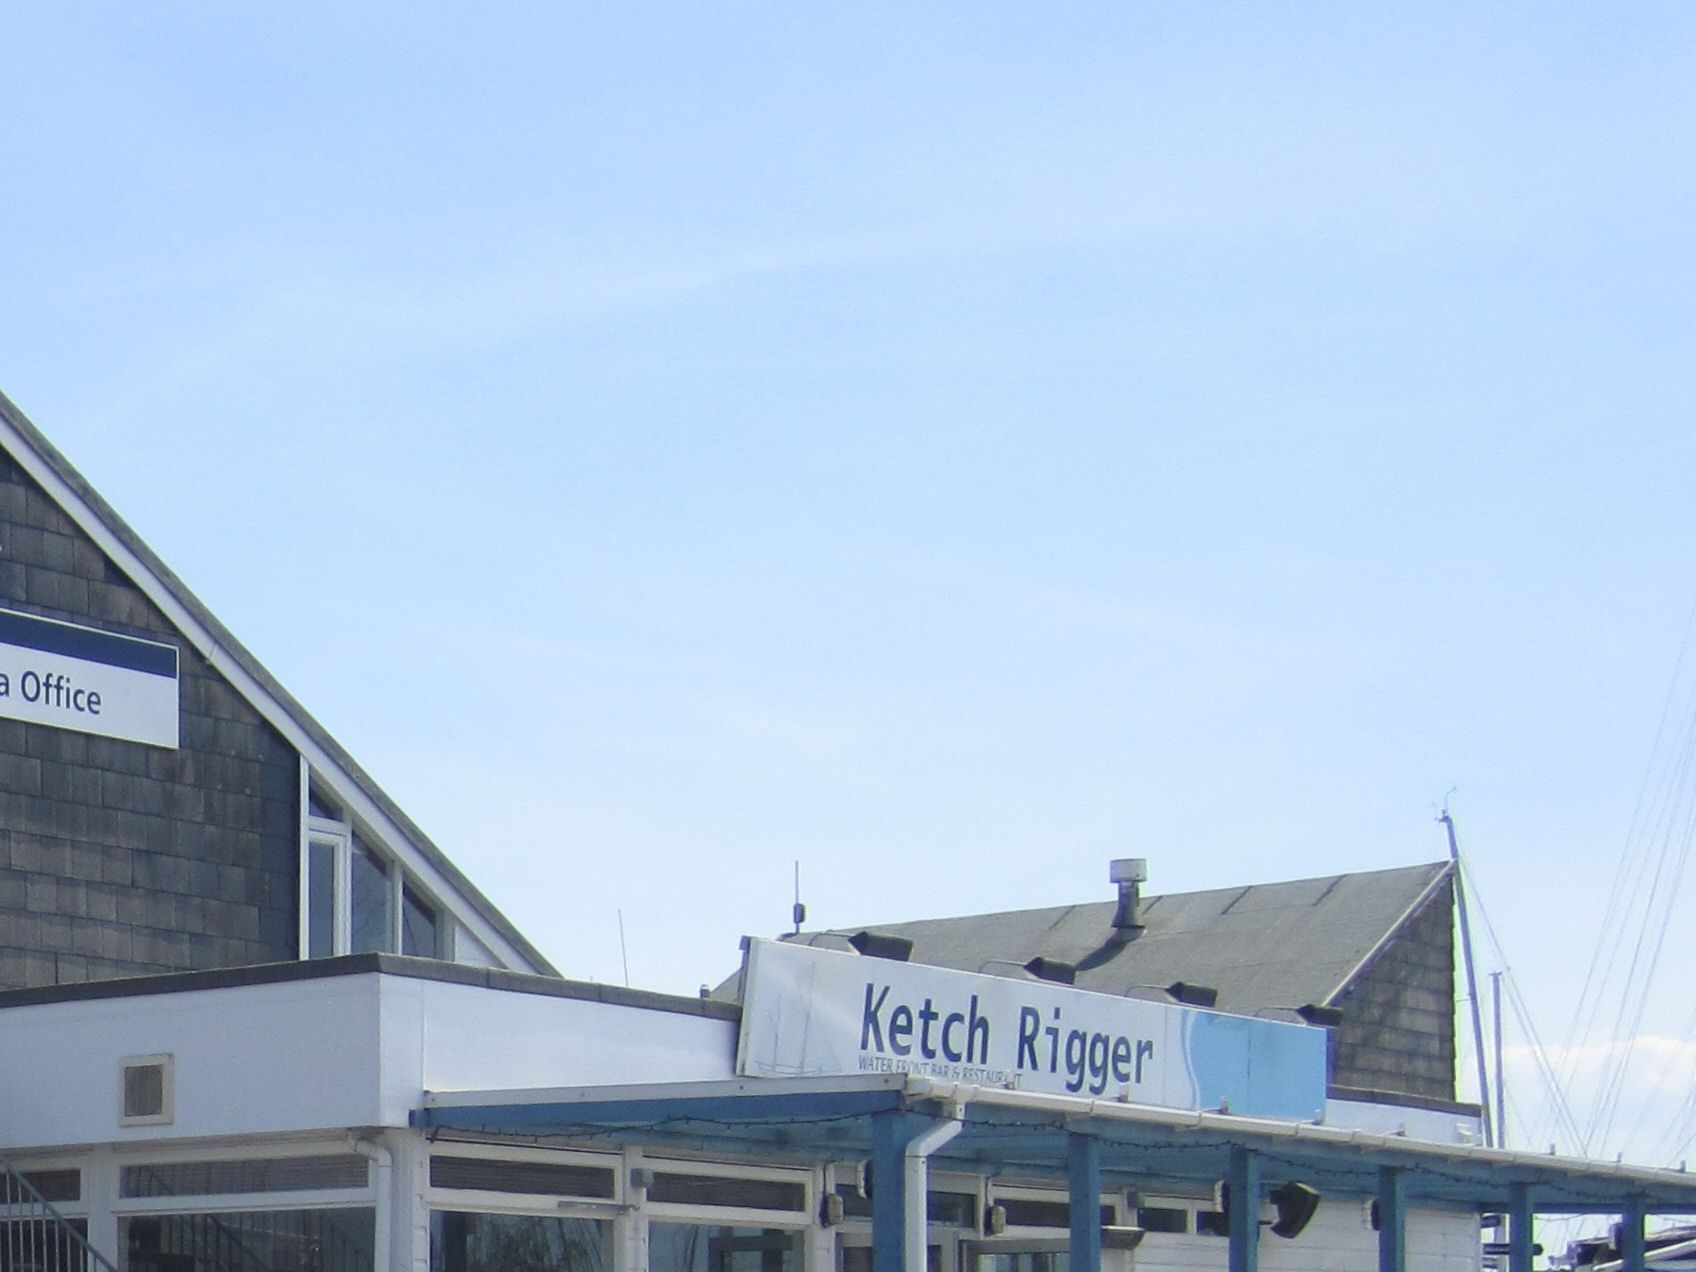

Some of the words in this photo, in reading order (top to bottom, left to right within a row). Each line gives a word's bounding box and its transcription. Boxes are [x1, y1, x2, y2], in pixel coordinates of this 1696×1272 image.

[20, 670, 102, 715] Office
[860, 982, 990, 1066] Ketch
[1017, 1005, 1154, 1094] Rigger
[858, 1055, 892, 1073] WATER
